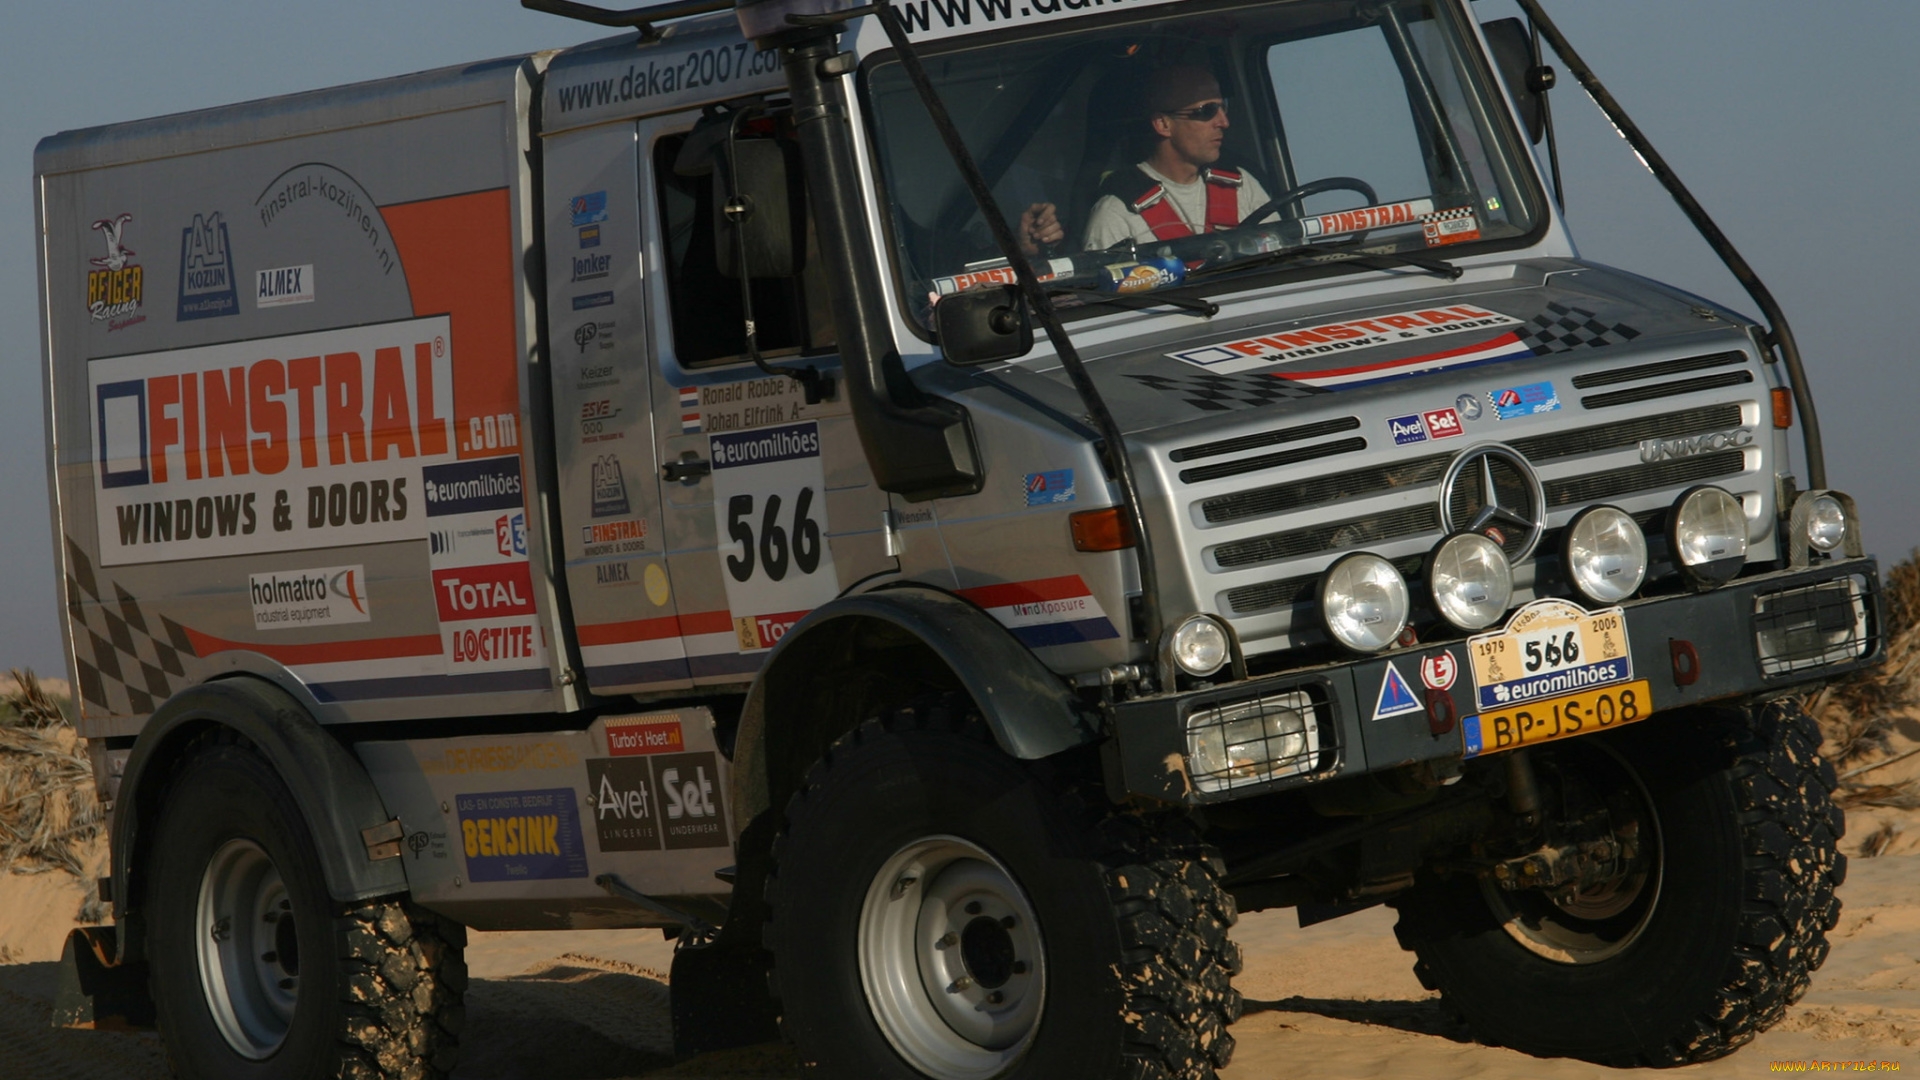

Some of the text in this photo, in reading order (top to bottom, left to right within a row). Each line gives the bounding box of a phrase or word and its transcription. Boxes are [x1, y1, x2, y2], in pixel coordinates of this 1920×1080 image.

[559, 43, 784, 112] www.dakar2007.co
[260, 176, 395, 276] finstral-kozijnen.nl
[1320, 203, 1415, 235] FINSTRAL
[187, 211, 225, 269] A1
[188, 268, 226, 290] KOZIJN
[258, 268, 302, 298] ALMEX
[571, 254, 612, 283] Jonker
[89, 265, 142, 310] REIGER
[90, 298, 138, 324] Racing
[1224, 303, 1496, 356] FINSTRAL
[1260, 315, 1512, 363] WINDOWS & DOORS
[580, 365, 614, 380] Keizer
[702, 384, 743, 406] Ronald
[748, 378, 784, 399] Robbe
[463, 413, 519, 452] .com
[705, 412, 740, 432] Johan
[744, 406, 784, 427] Elfrink
[1393, 420, 1423, 438] Avet
[1428, 411, 1458, 431] Set
[727, 431, 818, 463] euromilhões
[438, 473, 521, 502] euromilhões
[116, 477, 408, 546] WINDOWS & DOORS
[898, 508, 933, 524] Wensink
[727, 487, 821, 582] 566
[596, 562, 630, 584] ALMEX
[251, 575, 327, 605] holmatro
[255, 605, 331, 623] industrial equipment
[453, 626, 533, 663] LOCTITE
[1479, 640, 1505, 656] 1979
[1525, 631, 1579, 672] 566
[1432, 656, 1447, 679] E
[1511, 664, 1617, 699] euromilhões
[1494, 689, 1639, 748] BP-JS-08
[610, 728, 681, 749] Turbo's Hoet.nl
[598, 774, 649, 820] Avet
[662, 766, 716, 819] Set
[462, 815, 562, 858] BENSINK
[604, 828, 653, 839] LINGERIE
[669, 824, 719, 835] UNDERWEAR
